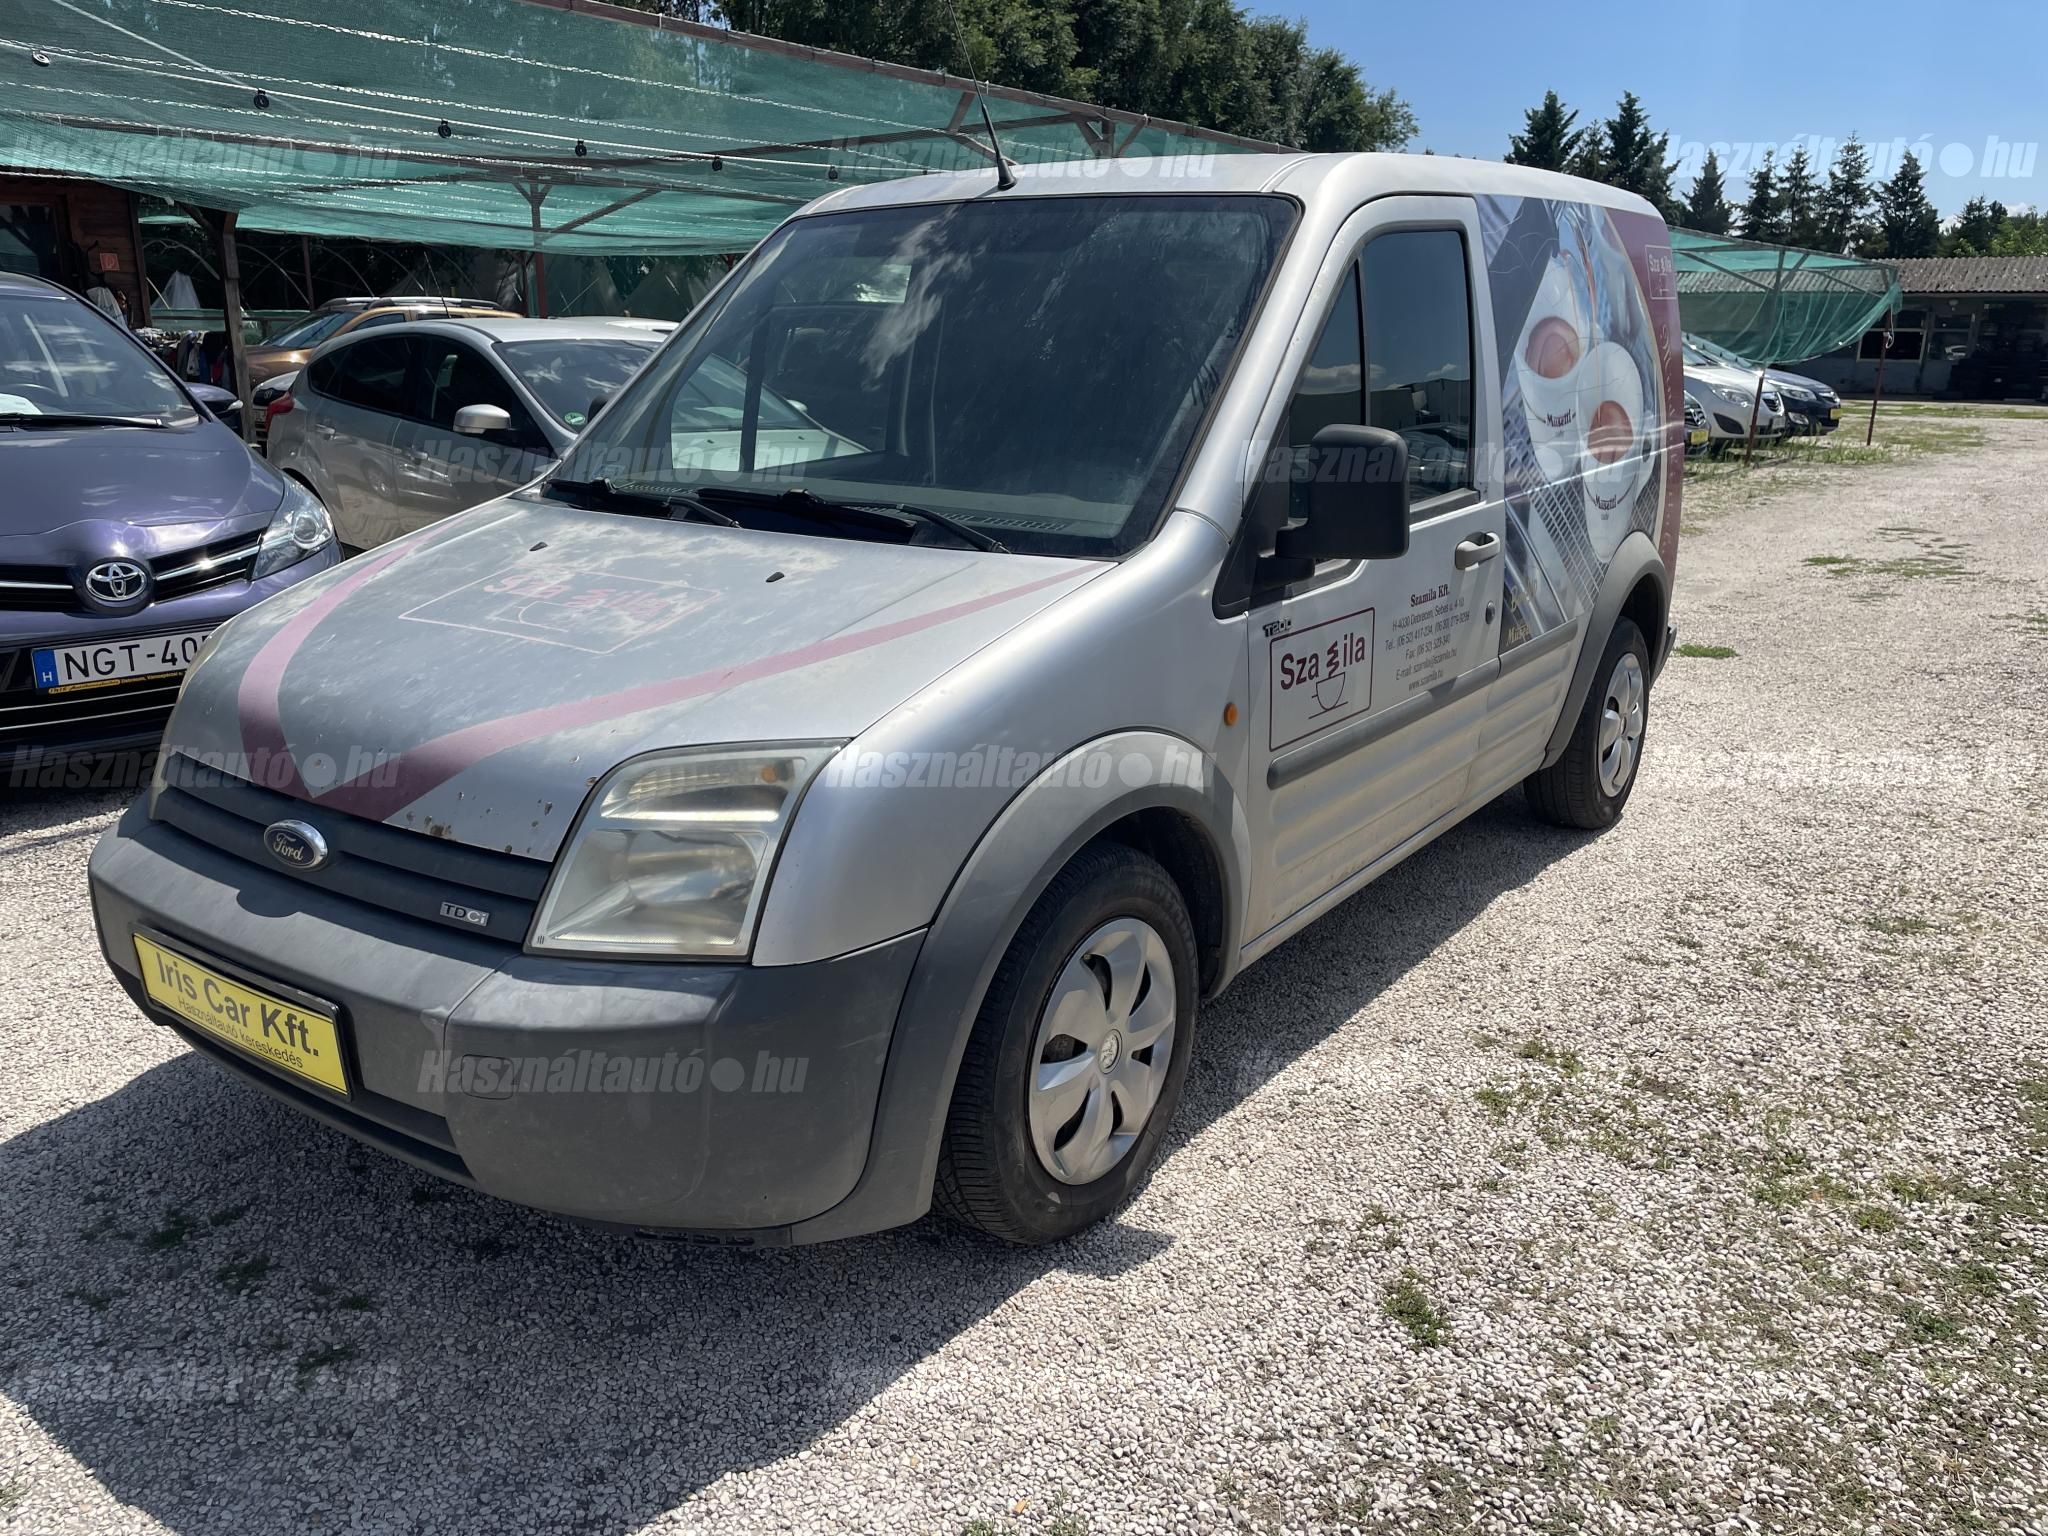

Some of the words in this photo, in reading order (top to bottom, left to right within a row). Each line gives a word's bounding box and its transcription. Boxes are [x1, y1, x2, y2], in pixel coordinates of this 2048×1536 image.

[1411, 588, 1437, 607] Szamila
[42, 671, 53, 682] H
[273, 832, 304, 862] Ford
[442, 903, 487, 926] TDCi
[156, 952, 198, 1000] Iris
[203, 978, 250, 1027] Car
[260, 1003, 319, 1057] Kft.
[178, 996, 239, 1041] Használtautó
[239, 1028, 304, 1069] kereskedés
